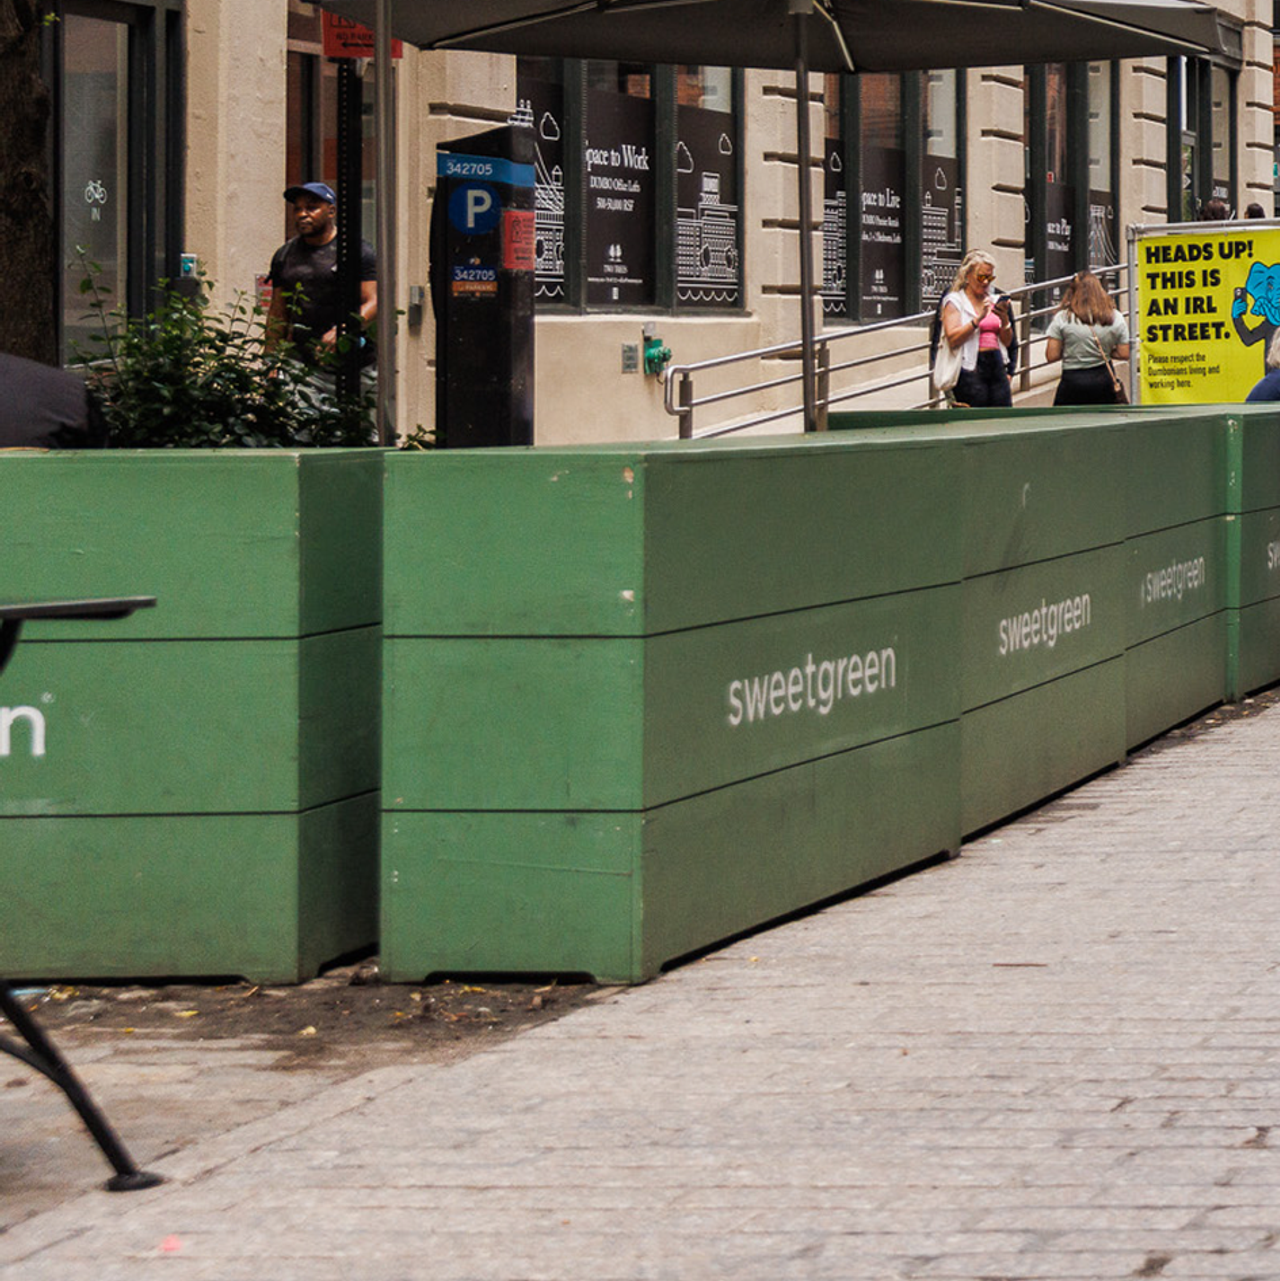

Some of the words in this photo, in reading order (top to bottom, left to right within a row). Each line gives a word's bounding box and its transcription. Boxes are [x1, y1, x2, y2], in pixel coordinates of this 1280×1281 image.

[585, 140, 609, 172] pace
[611, 148, 621, 167] to
[622, 144, 649, 171] Work
[446, 162, 493, 176] 342705
[590, 176, 612, 189] DUMBO
[466, 189, 492, 228] P
[861, 192, 877, 212] pace
[886, 187, 901, 209] Live
[1145, 243, 1214, 264] HEADS
[1219, 240, 1253, 260] UP!
[454, 270, 496, 281] 342705
[1147, 271, 1196, 290] THIS
[1202, 269, 1221, 287] IS
[1147, 297, 1178, 317] AN
[1185, 296, 1217, 315] IRL
[1147, 322, 1231, 343] STREET.
[1148, 354, 1169, 364] Please
[1170, 354, 1194, 365] respect
[1195, 353, 1206, 362] the
[1148, 368, 1188, 378] Dumbonians
[1189, 366, 1206, 377] living
[1208, 365, 1220, 375] and
[1149, 381, 1175, 391] working
[1176, 379, 1193, 389] here.
[1146, 556, 1206, 602] sweetgreen
[998, 593, 1092, 656] sweetgreen
[728, 646, 897, 726] sweetgreen
